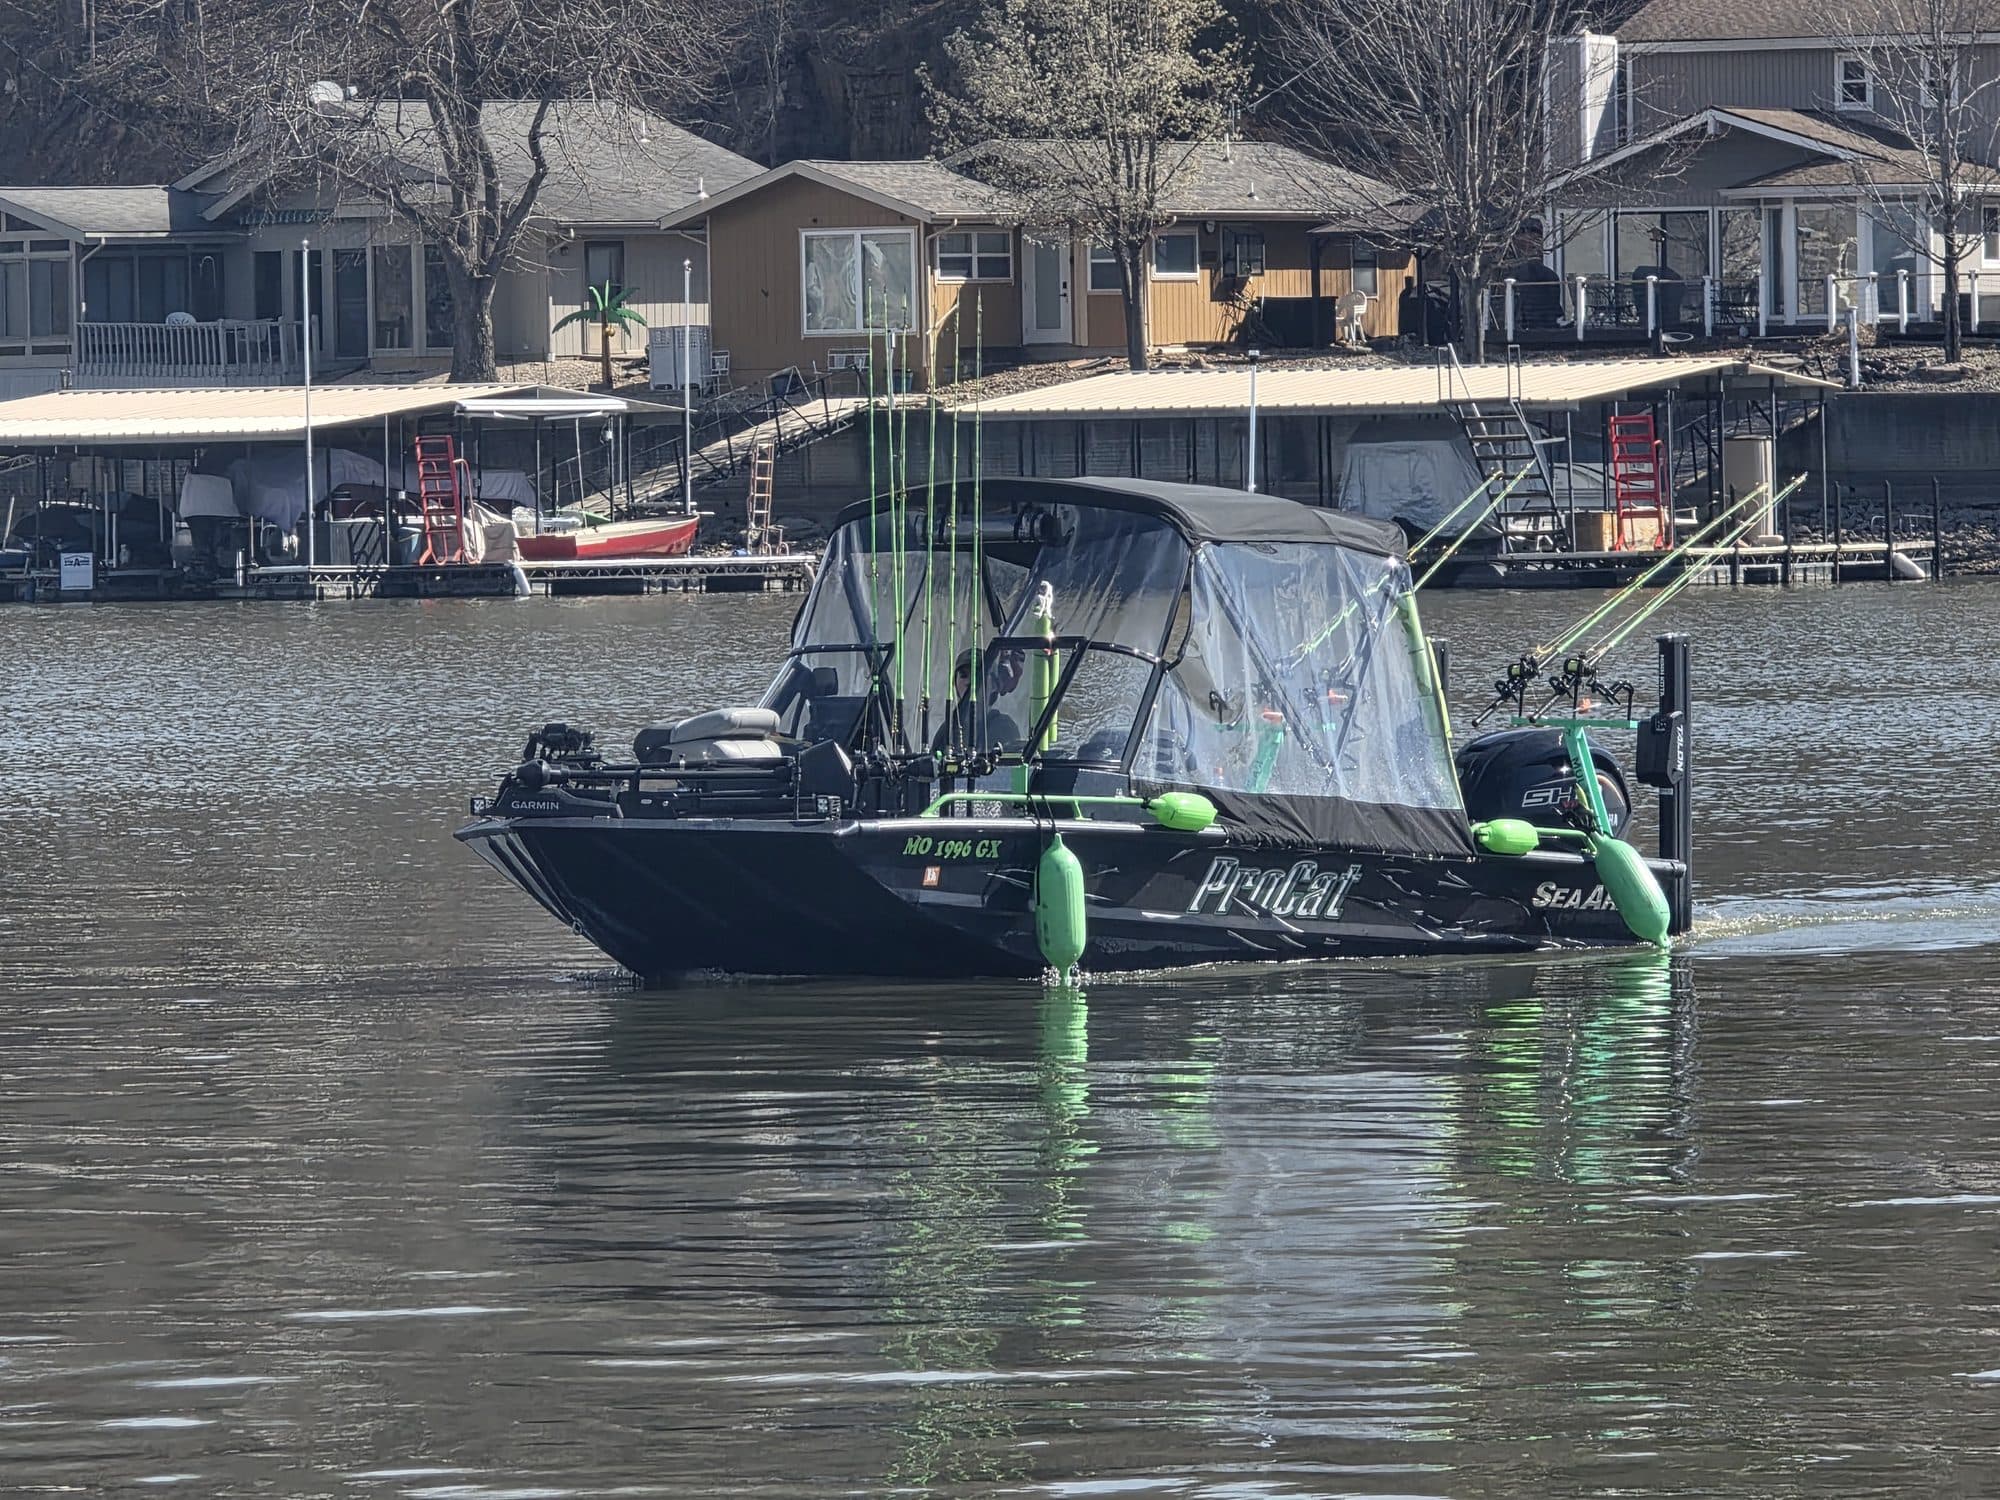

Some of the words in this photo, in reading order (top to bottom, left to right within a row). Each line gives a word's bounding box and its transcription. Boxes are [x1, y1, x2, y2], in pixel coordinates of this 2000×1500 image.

[1676, 724, 1684, 772] TALON
[511, 800, 559, 810] GARMIN
[902, 835, 932, 855] MO
[934, 840, 972, 859] 1996
[975, 840, 1003, 858] GX
[1186, 856, 1362, 920] ProCat
